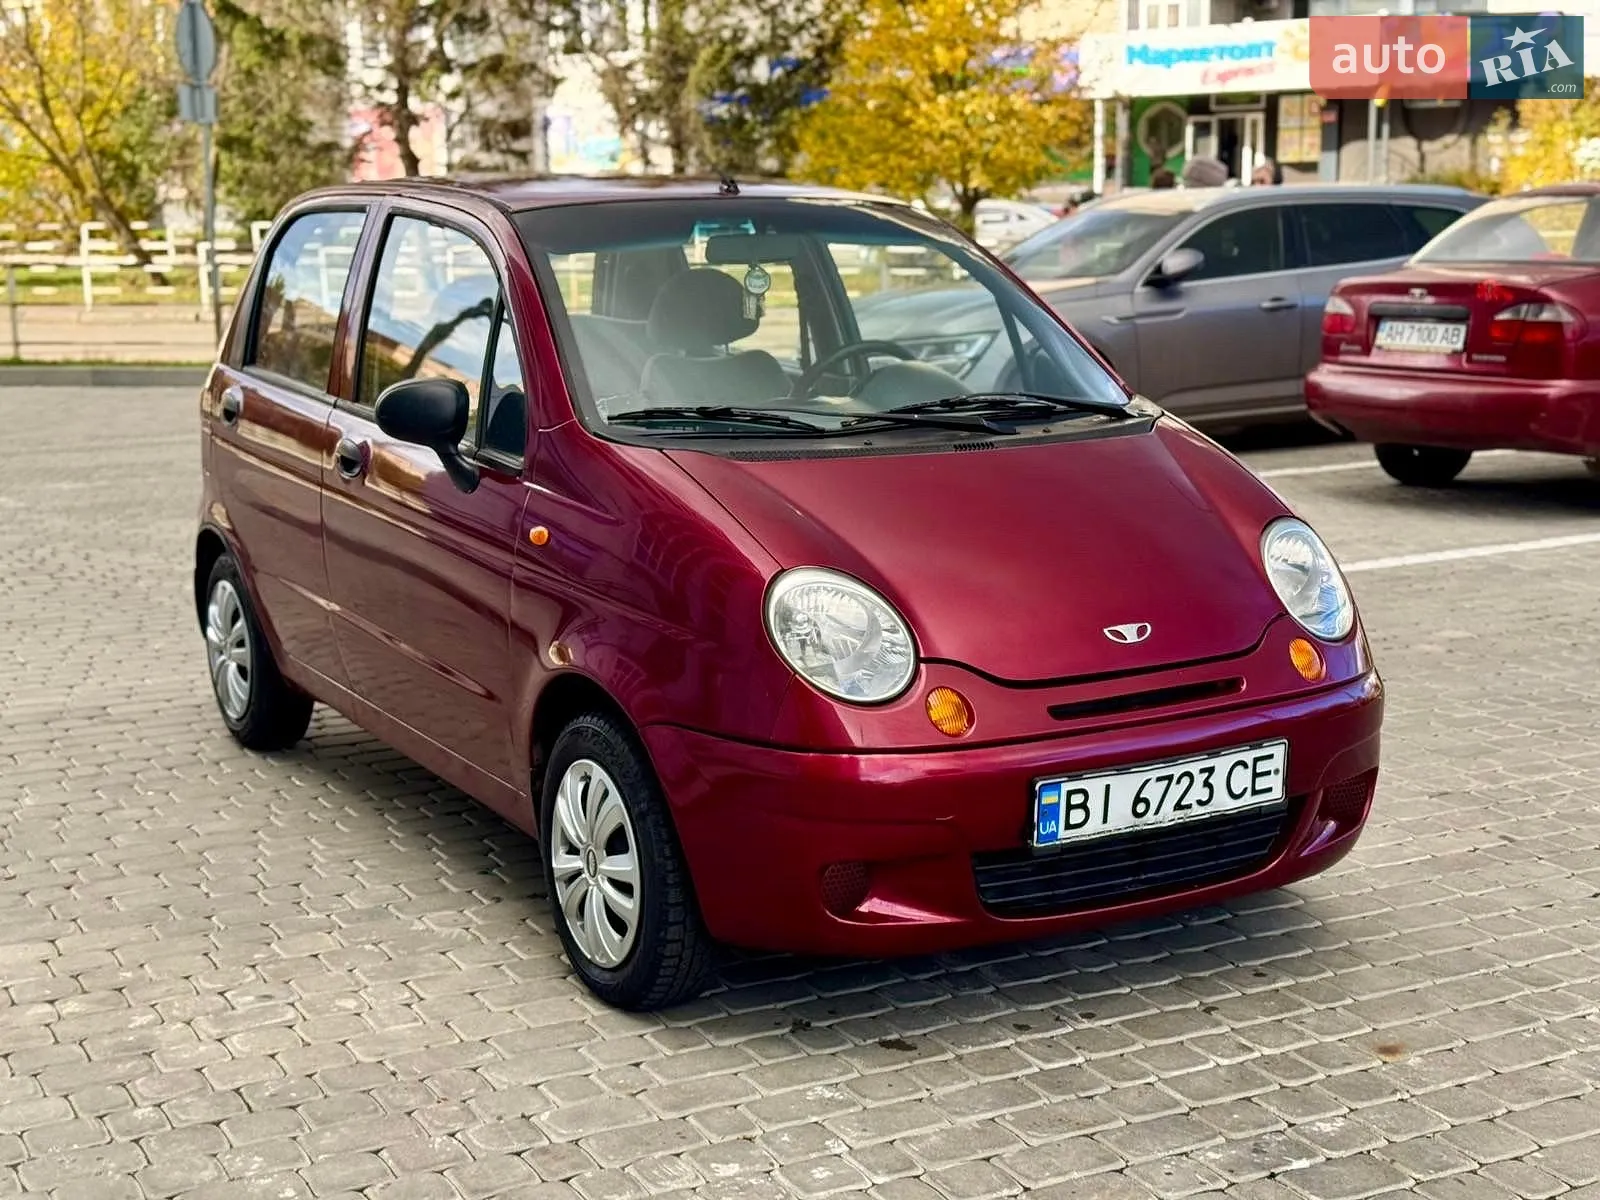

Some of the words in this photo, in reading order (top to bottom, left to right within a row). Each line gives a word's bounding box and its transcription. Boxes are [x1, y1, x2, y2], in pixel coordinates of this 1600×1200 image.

[1064, 783, 1111, 831] BI
[1131, 765, 1217, 819] 6723
[1225, 753, 1275, 800] CE
[1040, 820, 1057, 835] UA
